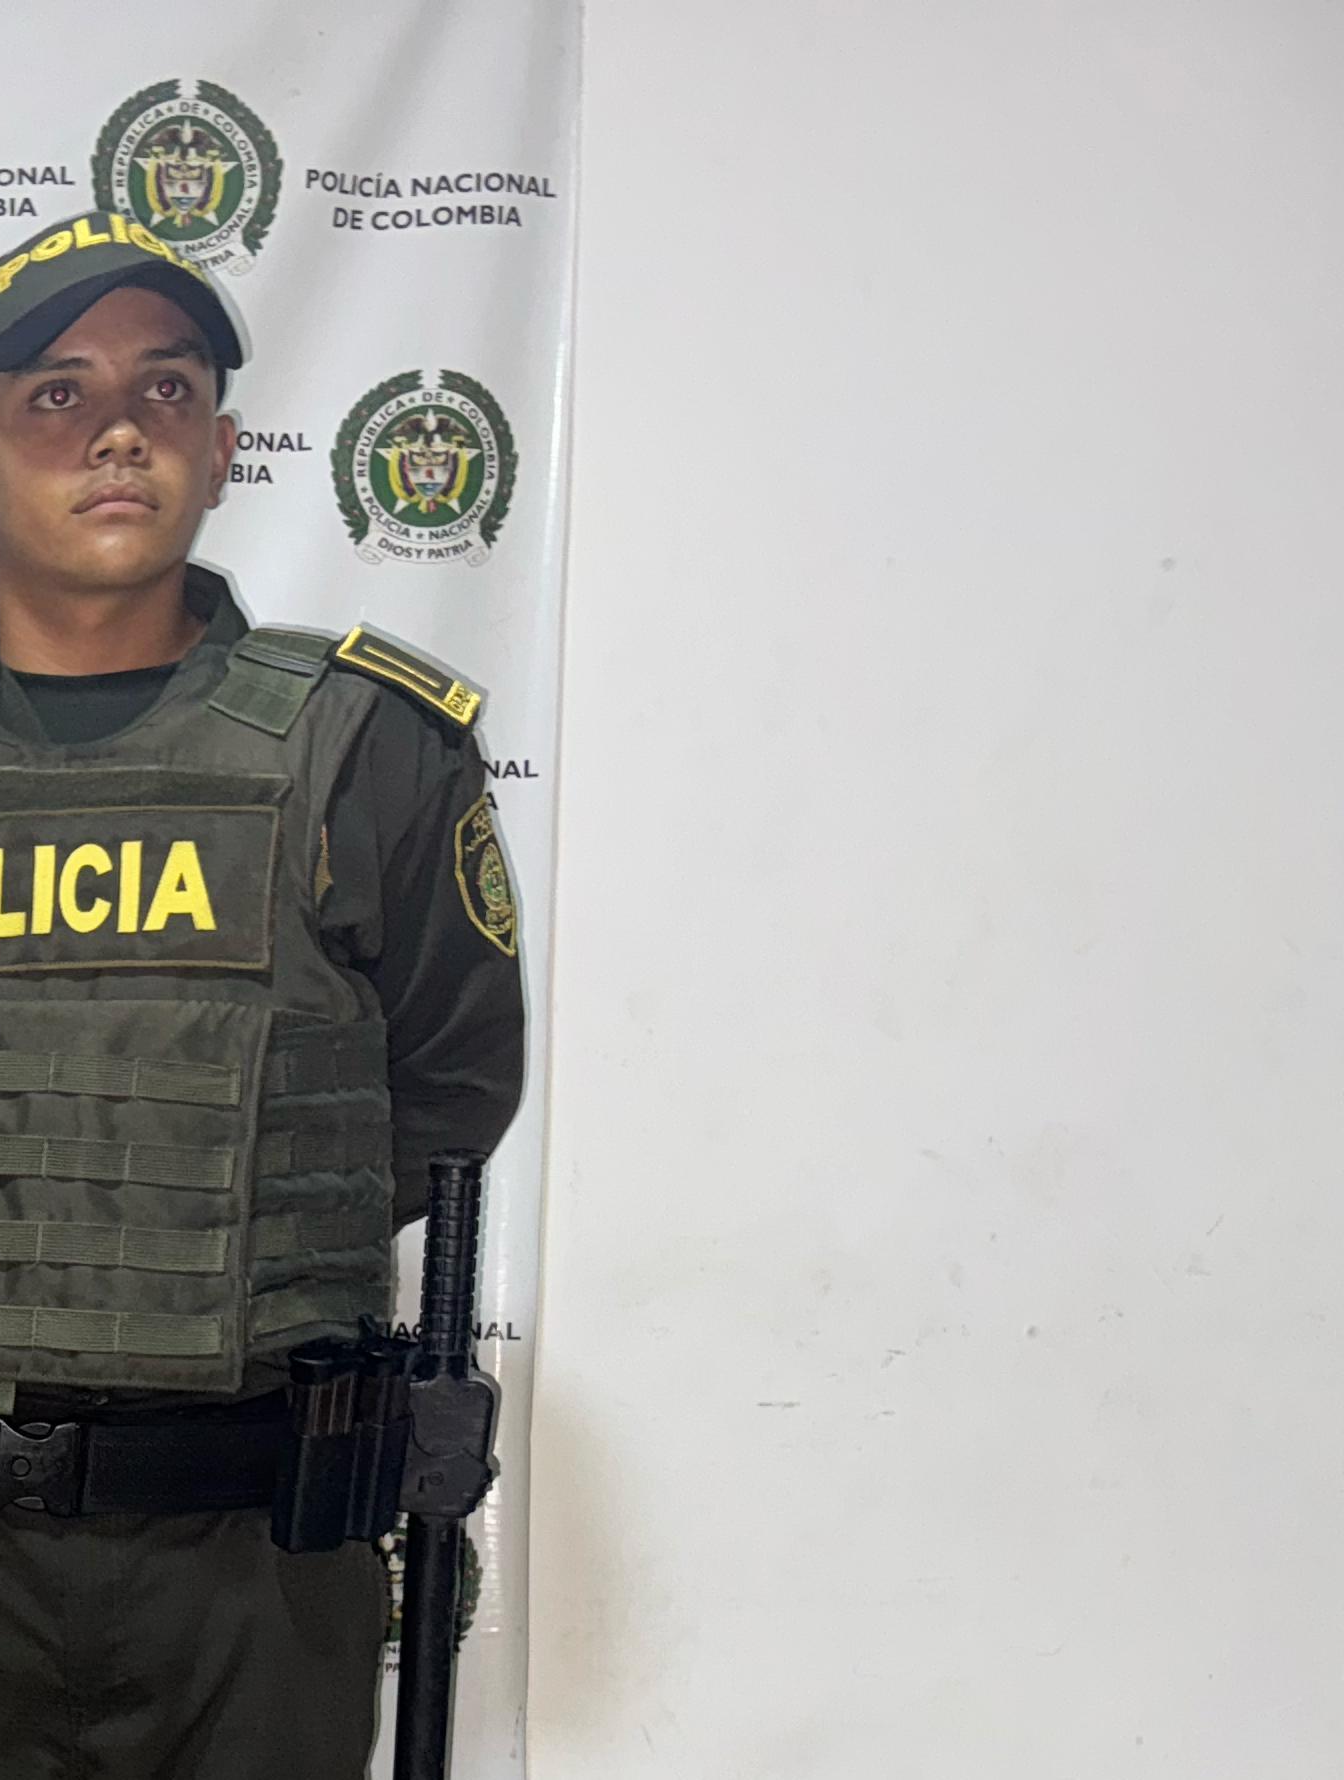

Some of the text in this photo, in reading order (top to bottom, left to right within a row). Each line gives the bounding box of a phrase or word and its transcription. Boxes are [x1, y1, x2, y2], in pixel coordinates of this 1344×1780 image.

[305, 168, 557, 198] POLICÍA NACIONAL
[332, 205, 522, 230] DE COLOMBIA
[236, 430, 312, 452] ONAL
